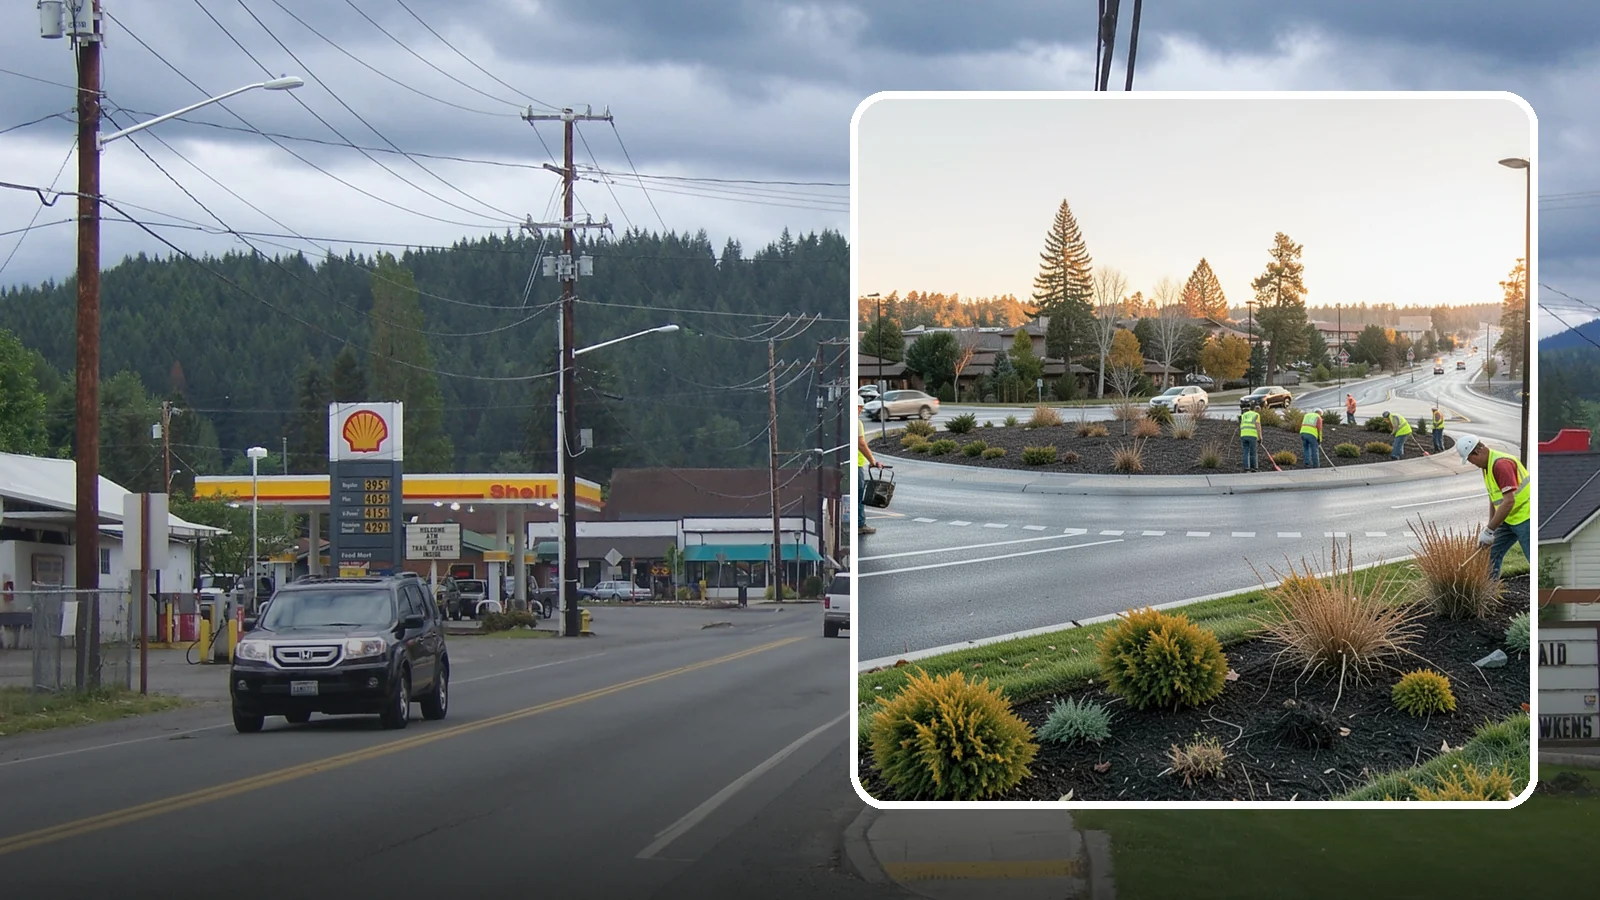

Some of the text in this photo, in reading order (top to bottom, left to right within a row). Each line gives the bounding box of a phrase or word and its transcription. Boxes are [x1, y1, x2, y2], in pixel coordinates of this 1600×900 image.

[366, 480, 383, 490] 395
[490, 484, 547, 499] Shell
[366, 494, 383, 504] 405
[366, 508, 383, 518] 415
[366, 522, 383, 532] 429
